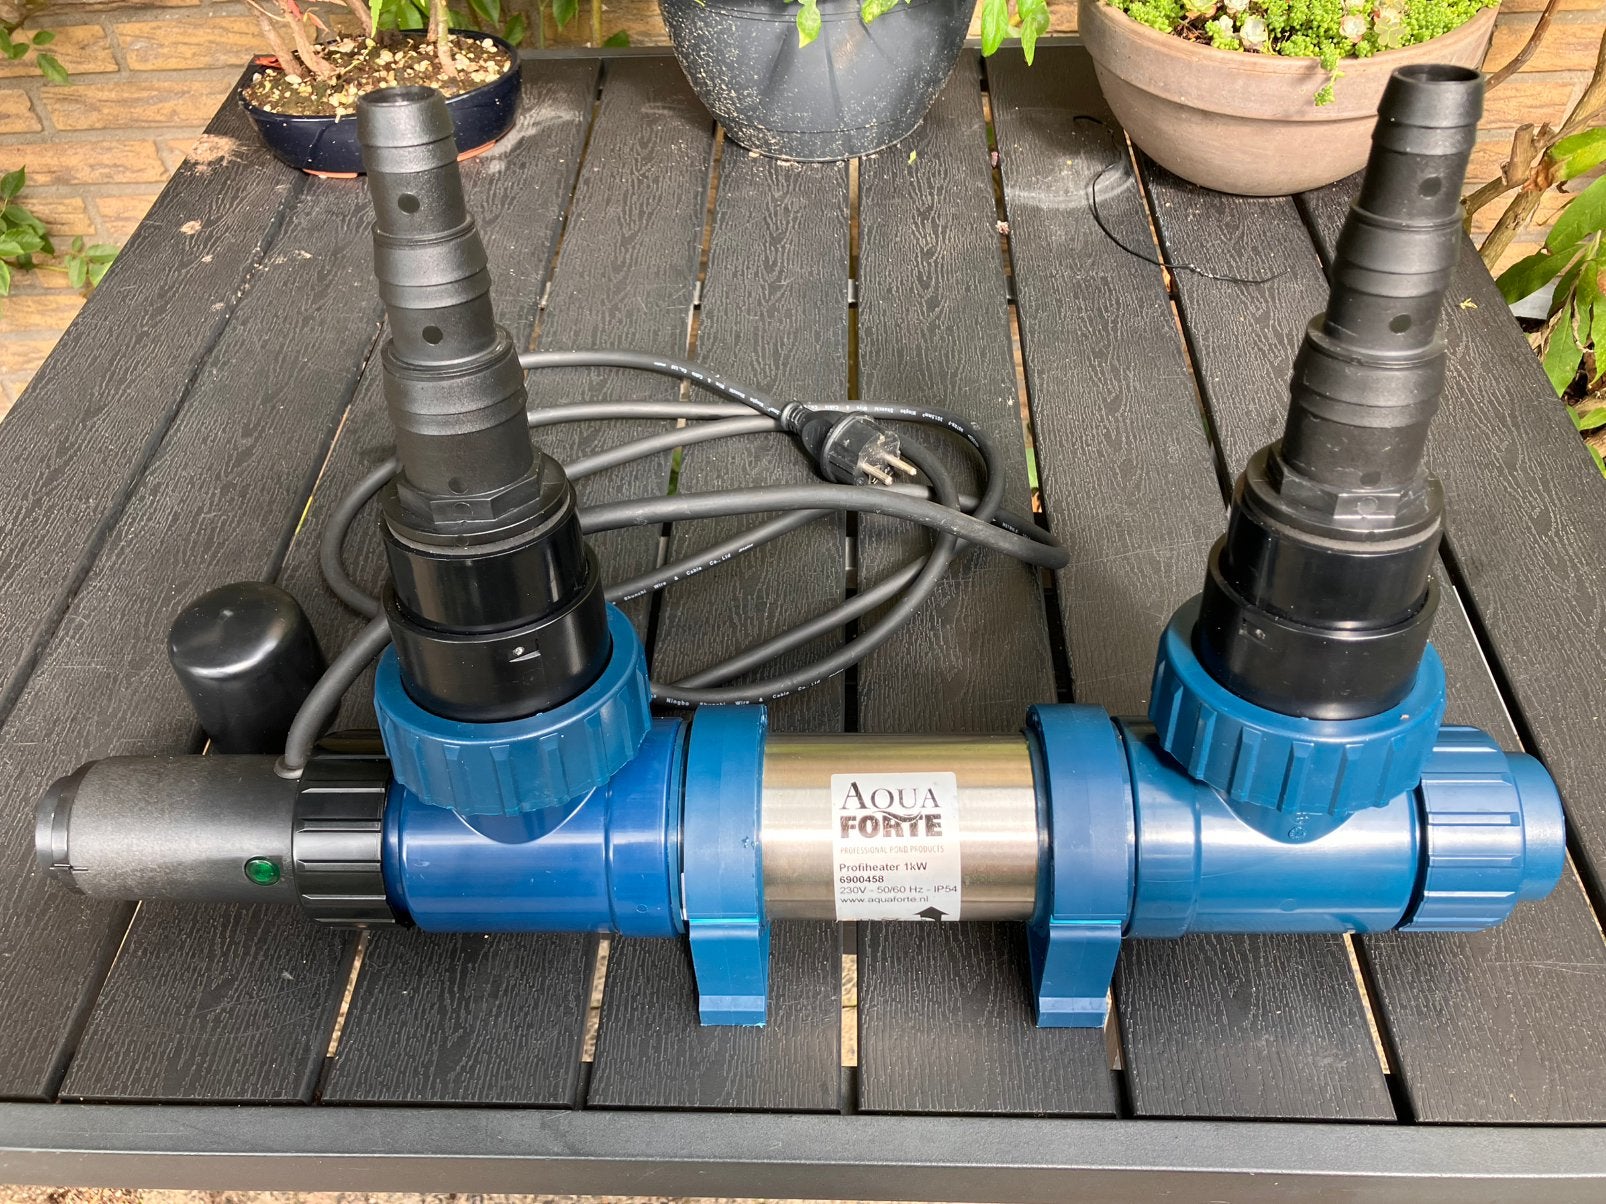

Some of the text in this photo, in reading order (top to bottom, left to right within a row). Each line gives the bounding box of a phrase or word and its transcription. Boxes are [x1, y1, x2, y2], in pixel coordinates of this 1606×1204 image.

[653, 581, 667, 590] Wire
[686, 566, 702, 576] Cable
[772, 691, 790, 699] Cable
[666, 697, 690, 707] Ningbo
[840, 781, 941, 810] AQUA
[840, 812, 943, 839] FORTE
[841, 845, 945, 855] PROFESSIONAL POND PRODUCTS
[839, 862, 928, 872] Profiheater 1kW
[839, 875, 885, 884] 6900458
[840, 886, 867, 894] 230V
[877, 885, 906, 894] 50/60
[909, 885, 924, 894] Hz
[934, 885, 958, 894] IP54
[840, 896, 929, 904] www.aquaforte.nl
